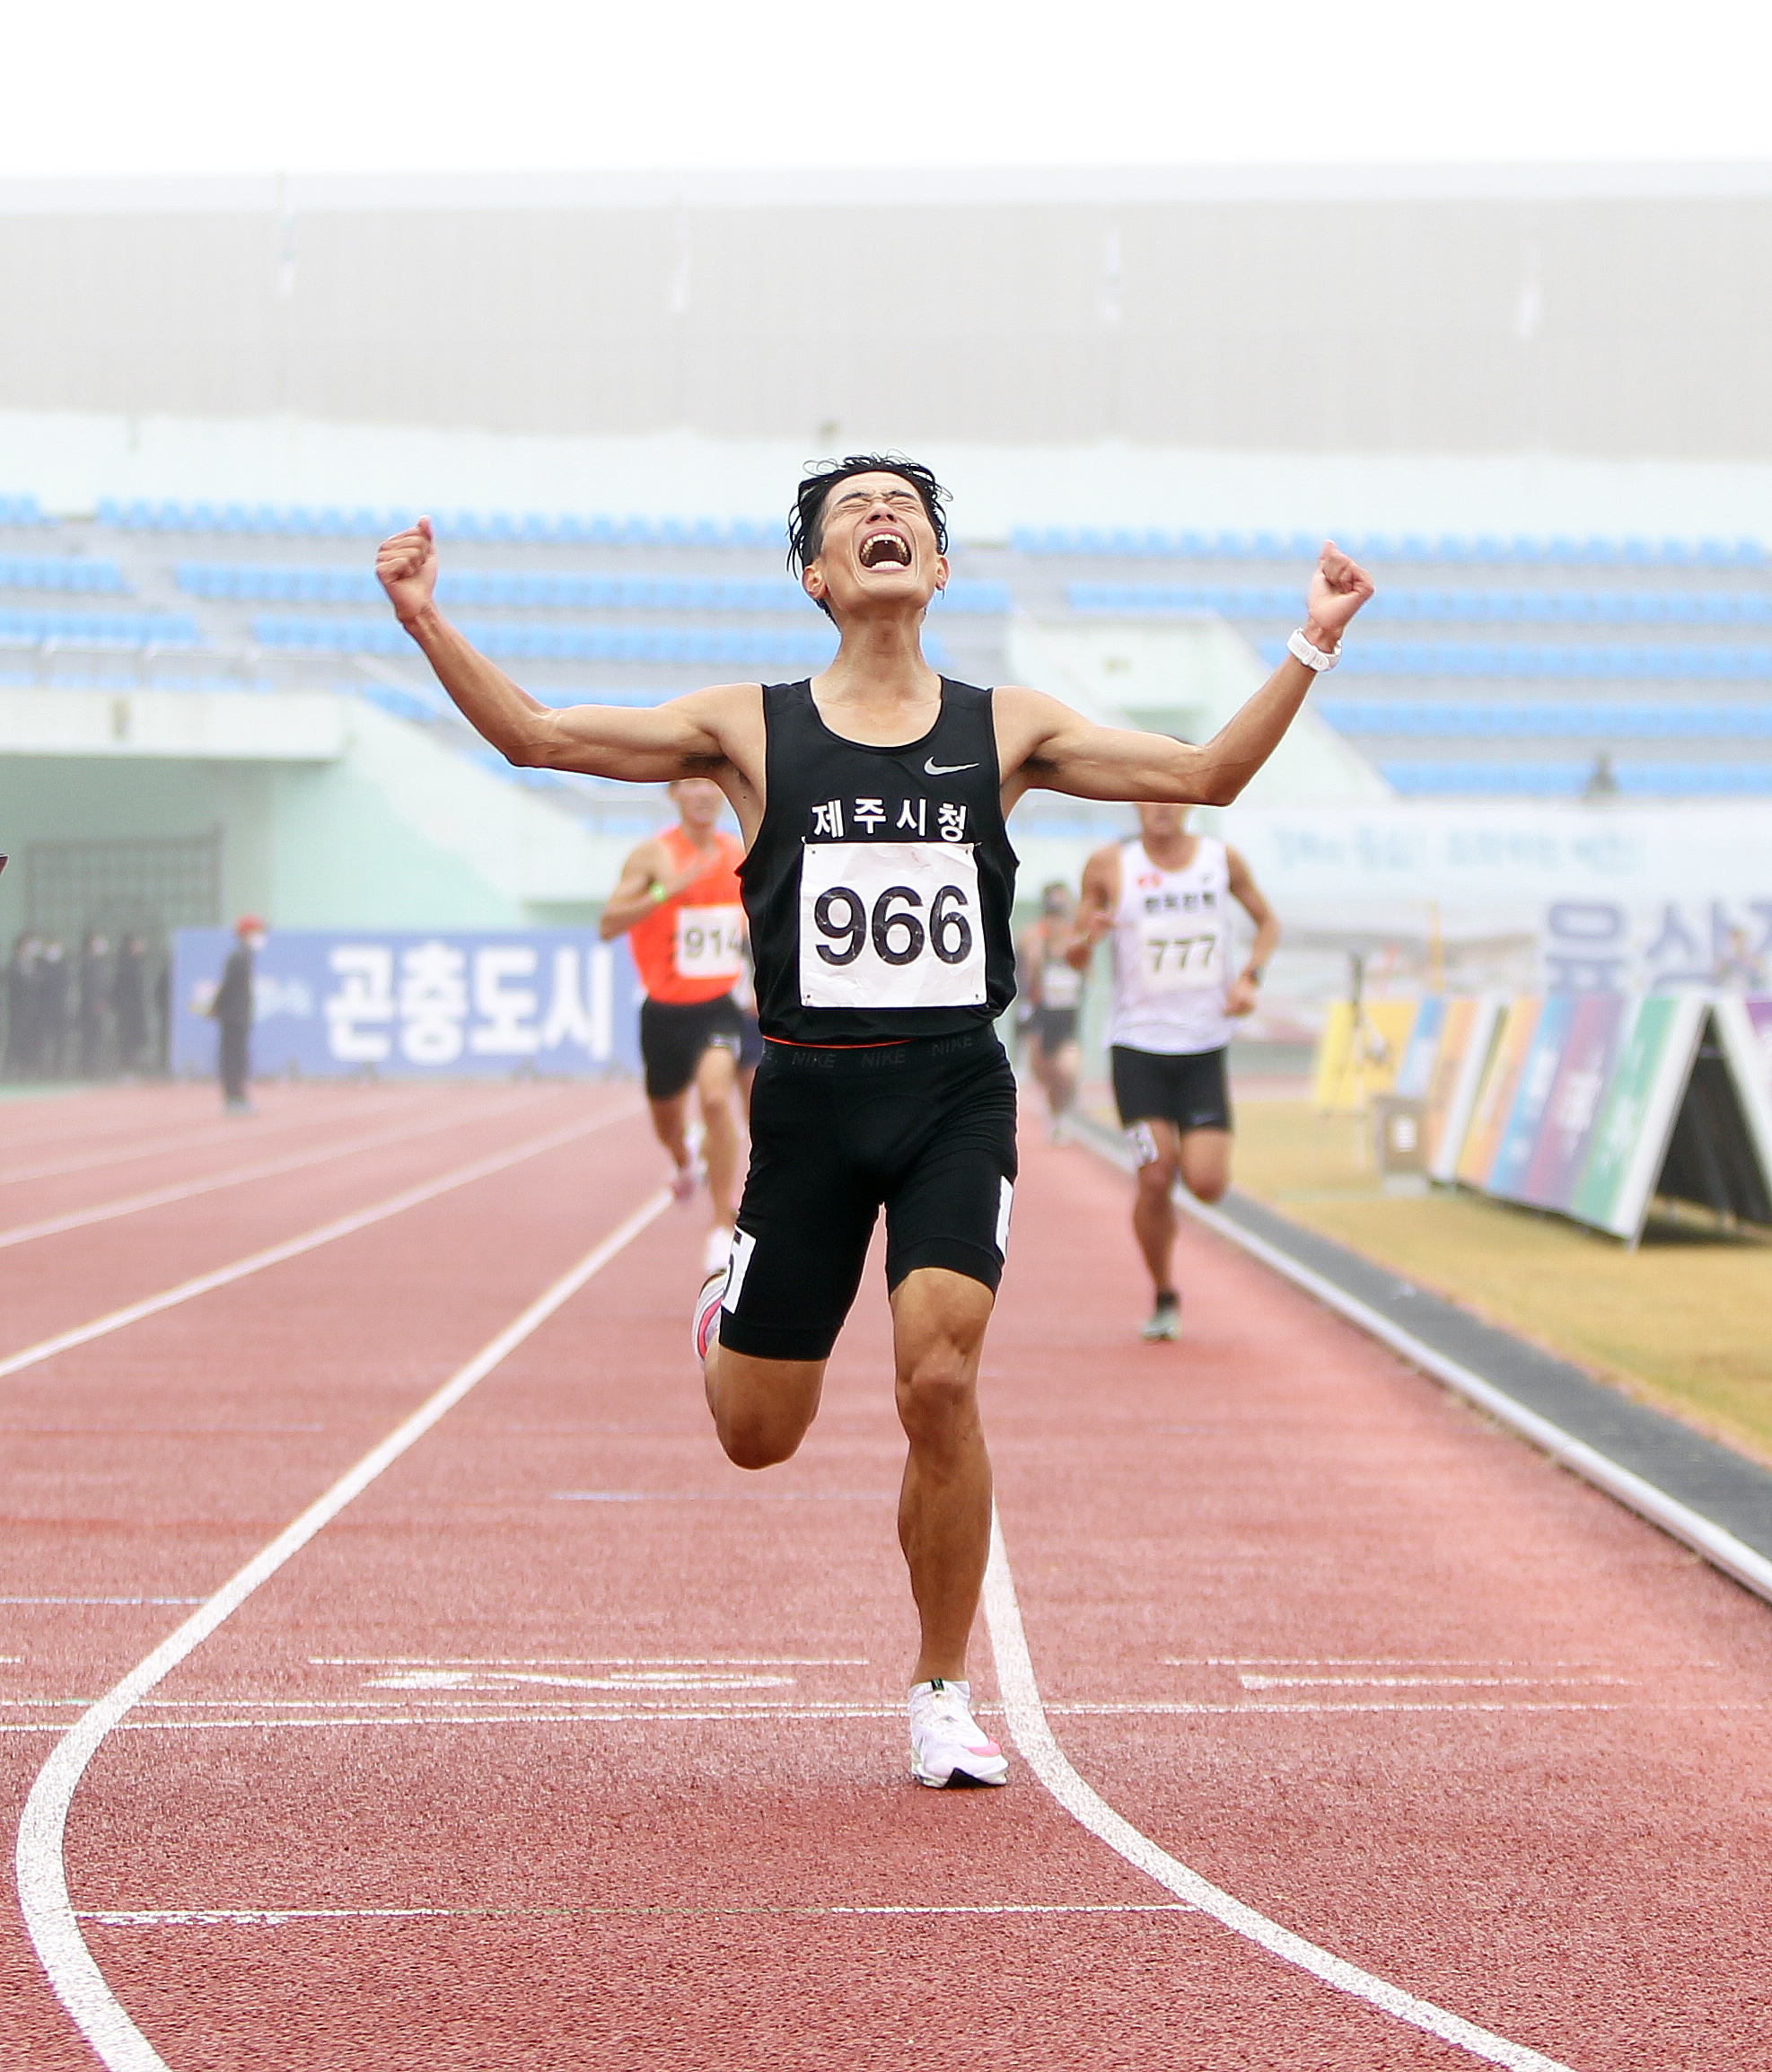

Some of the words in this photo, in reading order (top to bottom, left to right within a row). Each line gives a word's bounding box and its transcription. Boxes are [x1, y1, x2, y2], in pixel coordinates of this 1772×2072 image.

[811, 798, 967, 842] 제주시청
[683, 926, 746, 958] 914
[814, 885, 972, 966] 966
[1146, 934, 1216, 972] 777
[324, 942, 616, 1066] 곤충도시
[792, 1052, 836, 1068] NIKE
[861, 1049, 906, 1067] NIKE
[932, 1037, 974, 1056] NIKE
